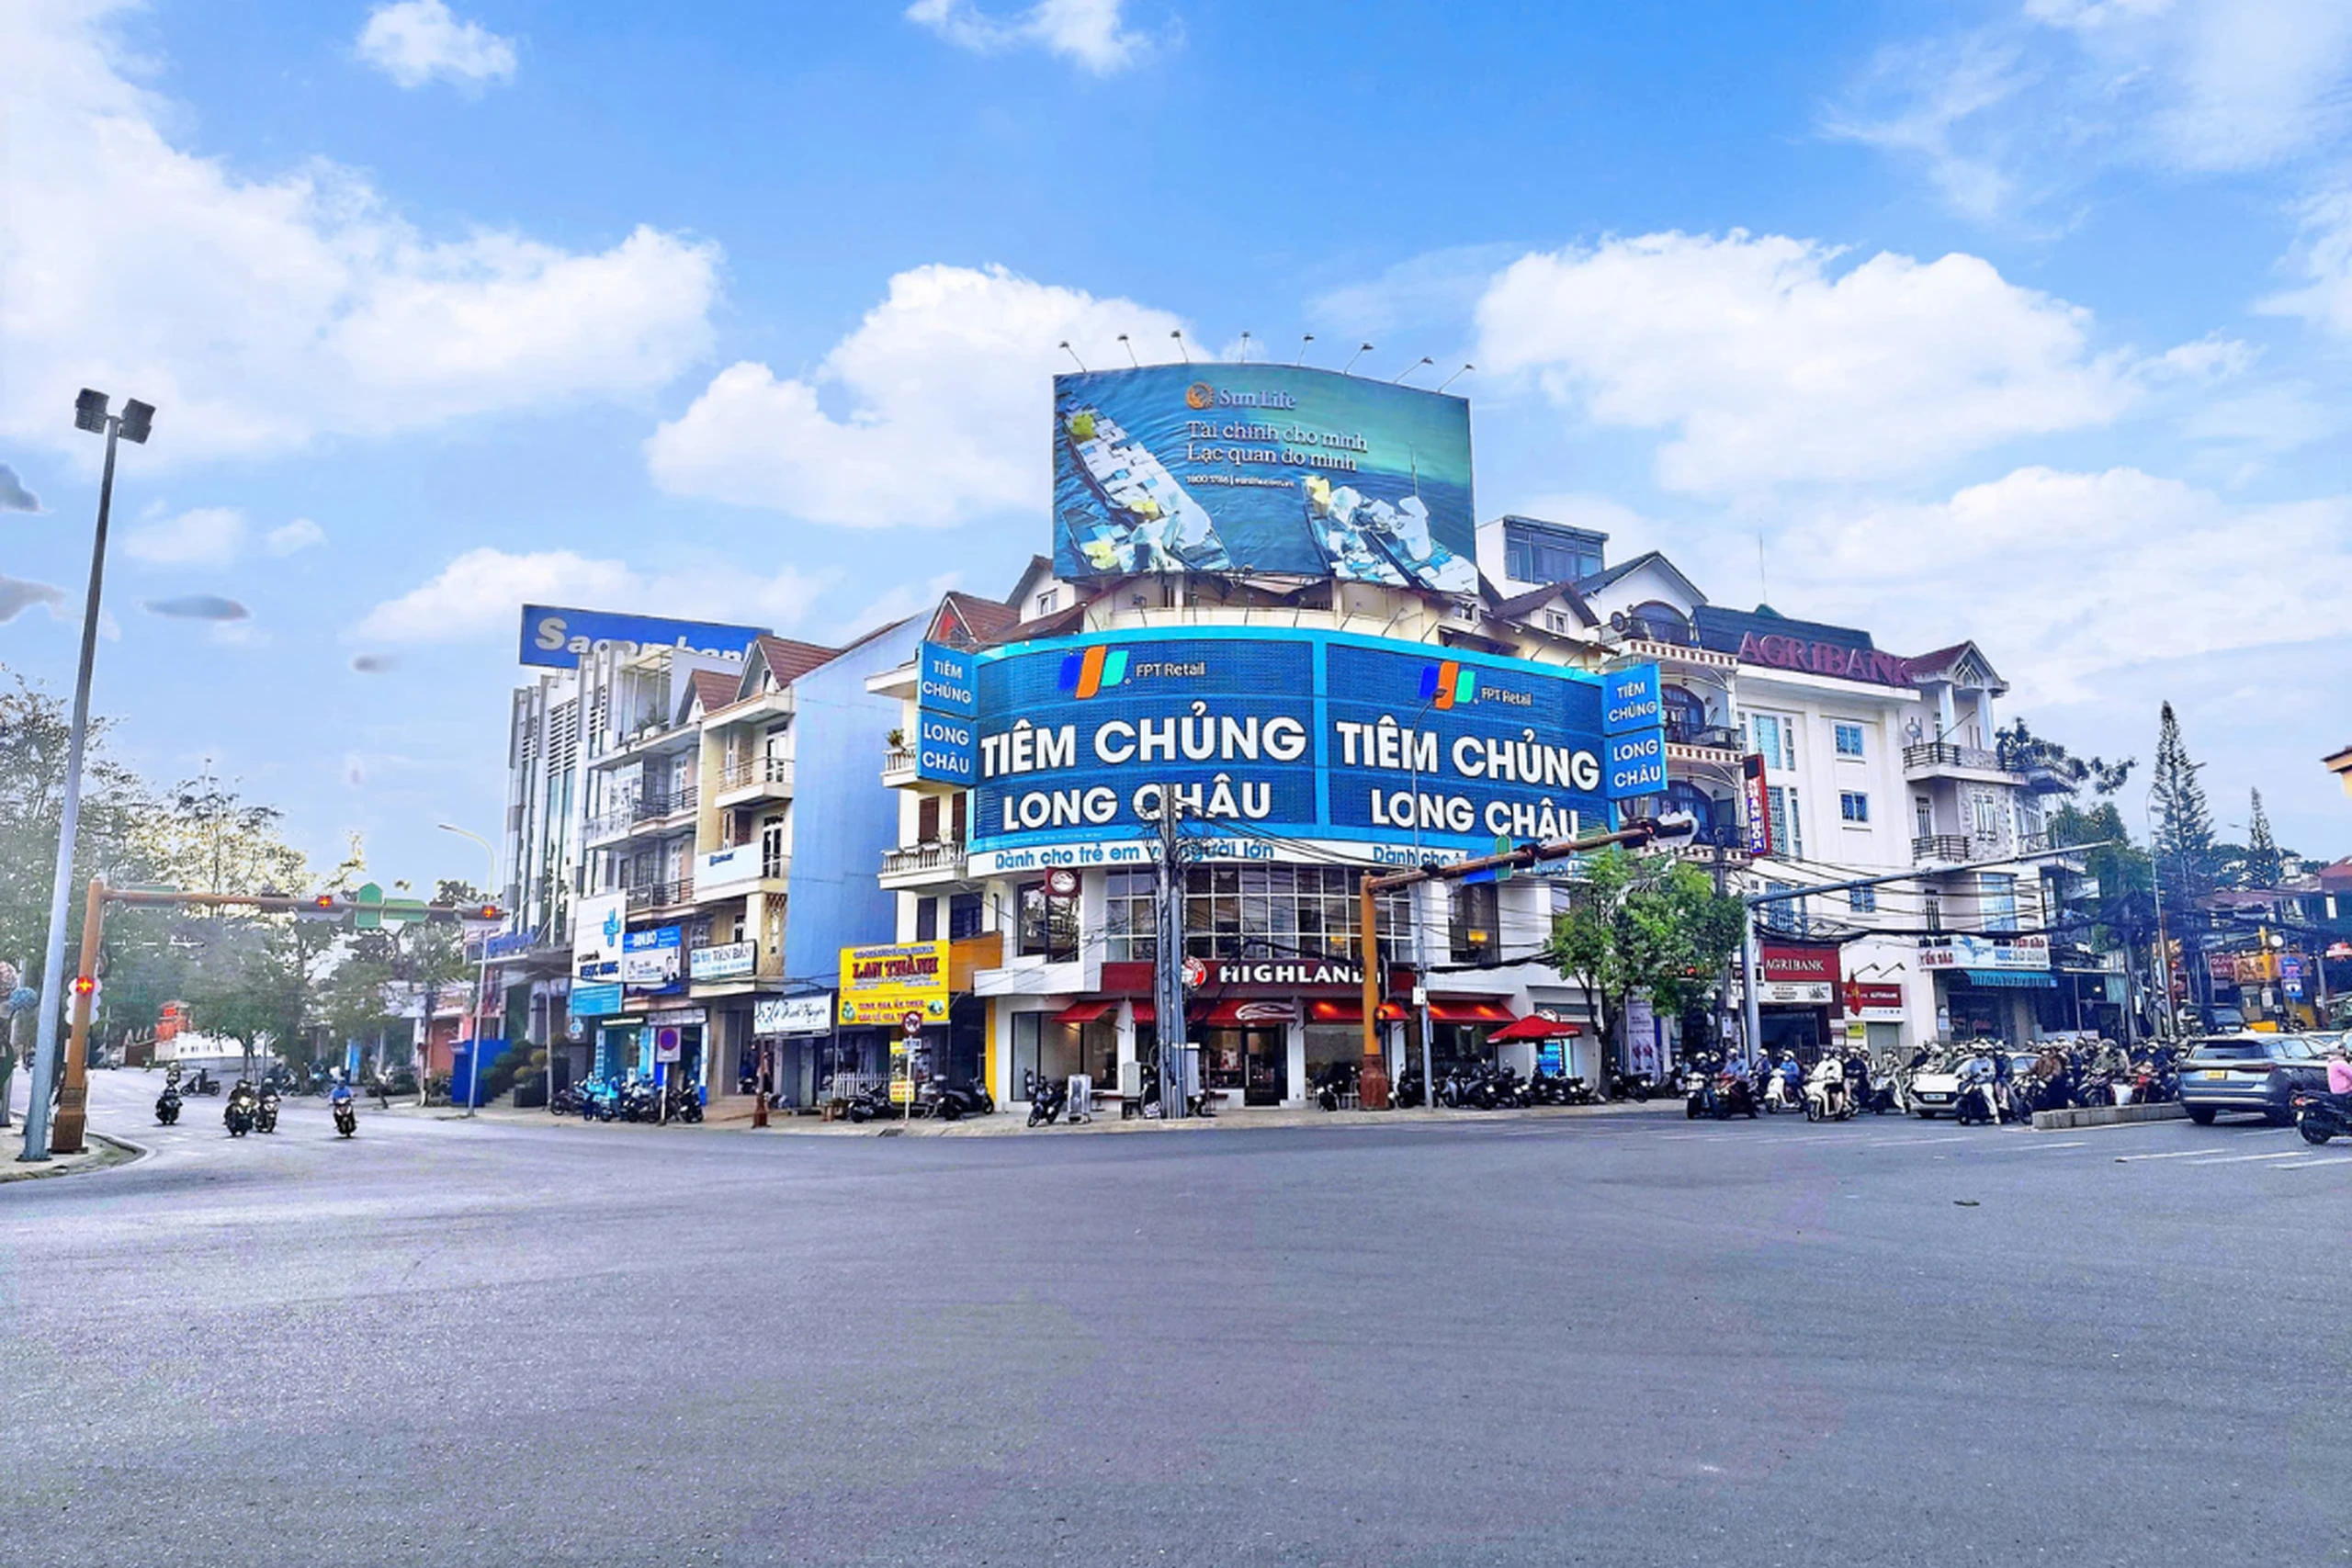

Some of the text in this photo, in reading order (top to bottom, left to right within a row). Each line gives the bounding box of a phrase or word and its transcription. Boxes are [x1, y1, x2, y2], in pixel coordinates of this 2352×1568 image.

[1218, 388, 1297, 411] Sun Life
[1186, 421, 1218, 440] Tài
[1222, 421, 1280, 442] chính
[1283, 425, 1318, 446] cho
[1187, 444, 1224, 465] Lạc
[1227, 447, 1277, 467] quan
[1281, 447, 1306, 465] do
[1136, 661, 1205, 677] FPT Retail
[1736, 631, 1917, 685] AGRIBANK
[933, 660, 963, 680] TIÊM
[922, 681, 972, 705] CHỦNG
[1481, 686, 1532, 705] FPT Retail
[1616, 681, 1645, 699] TIÊM
[923, 722, 970, 747] LONG
[980, 700, 1307, 778] TIÊM CHỦNG
[1336, 715, 1600, 792] TIÊM CHỦNG
[1613, 739, 1659, 762] LONG
[922, 751, 970, 774] CHÂU
[1614, 764, 1662, 788] CHÂU
[1003, 773, 1272, 831] LONG CHÂU
[1371, 789, 1580, 840] LONG CHÂU
[995, 849, 1035, 869] Dành
[1040, 848, 1074, 864] cho
[1079, 842, 1103, 863] trẻ
[1110, 846, 1140, 861] em
[1243, 840, 1274, 859] lớn
[1373, 843, 1416, 865] Dành
[852, 961, 882, 979] LAN
[884, 954, 939, 976] THÀNH
[1219, 964, 1381, 984] HIGHLAN
[1766, 959, 1825, 972] AGRIBANK
